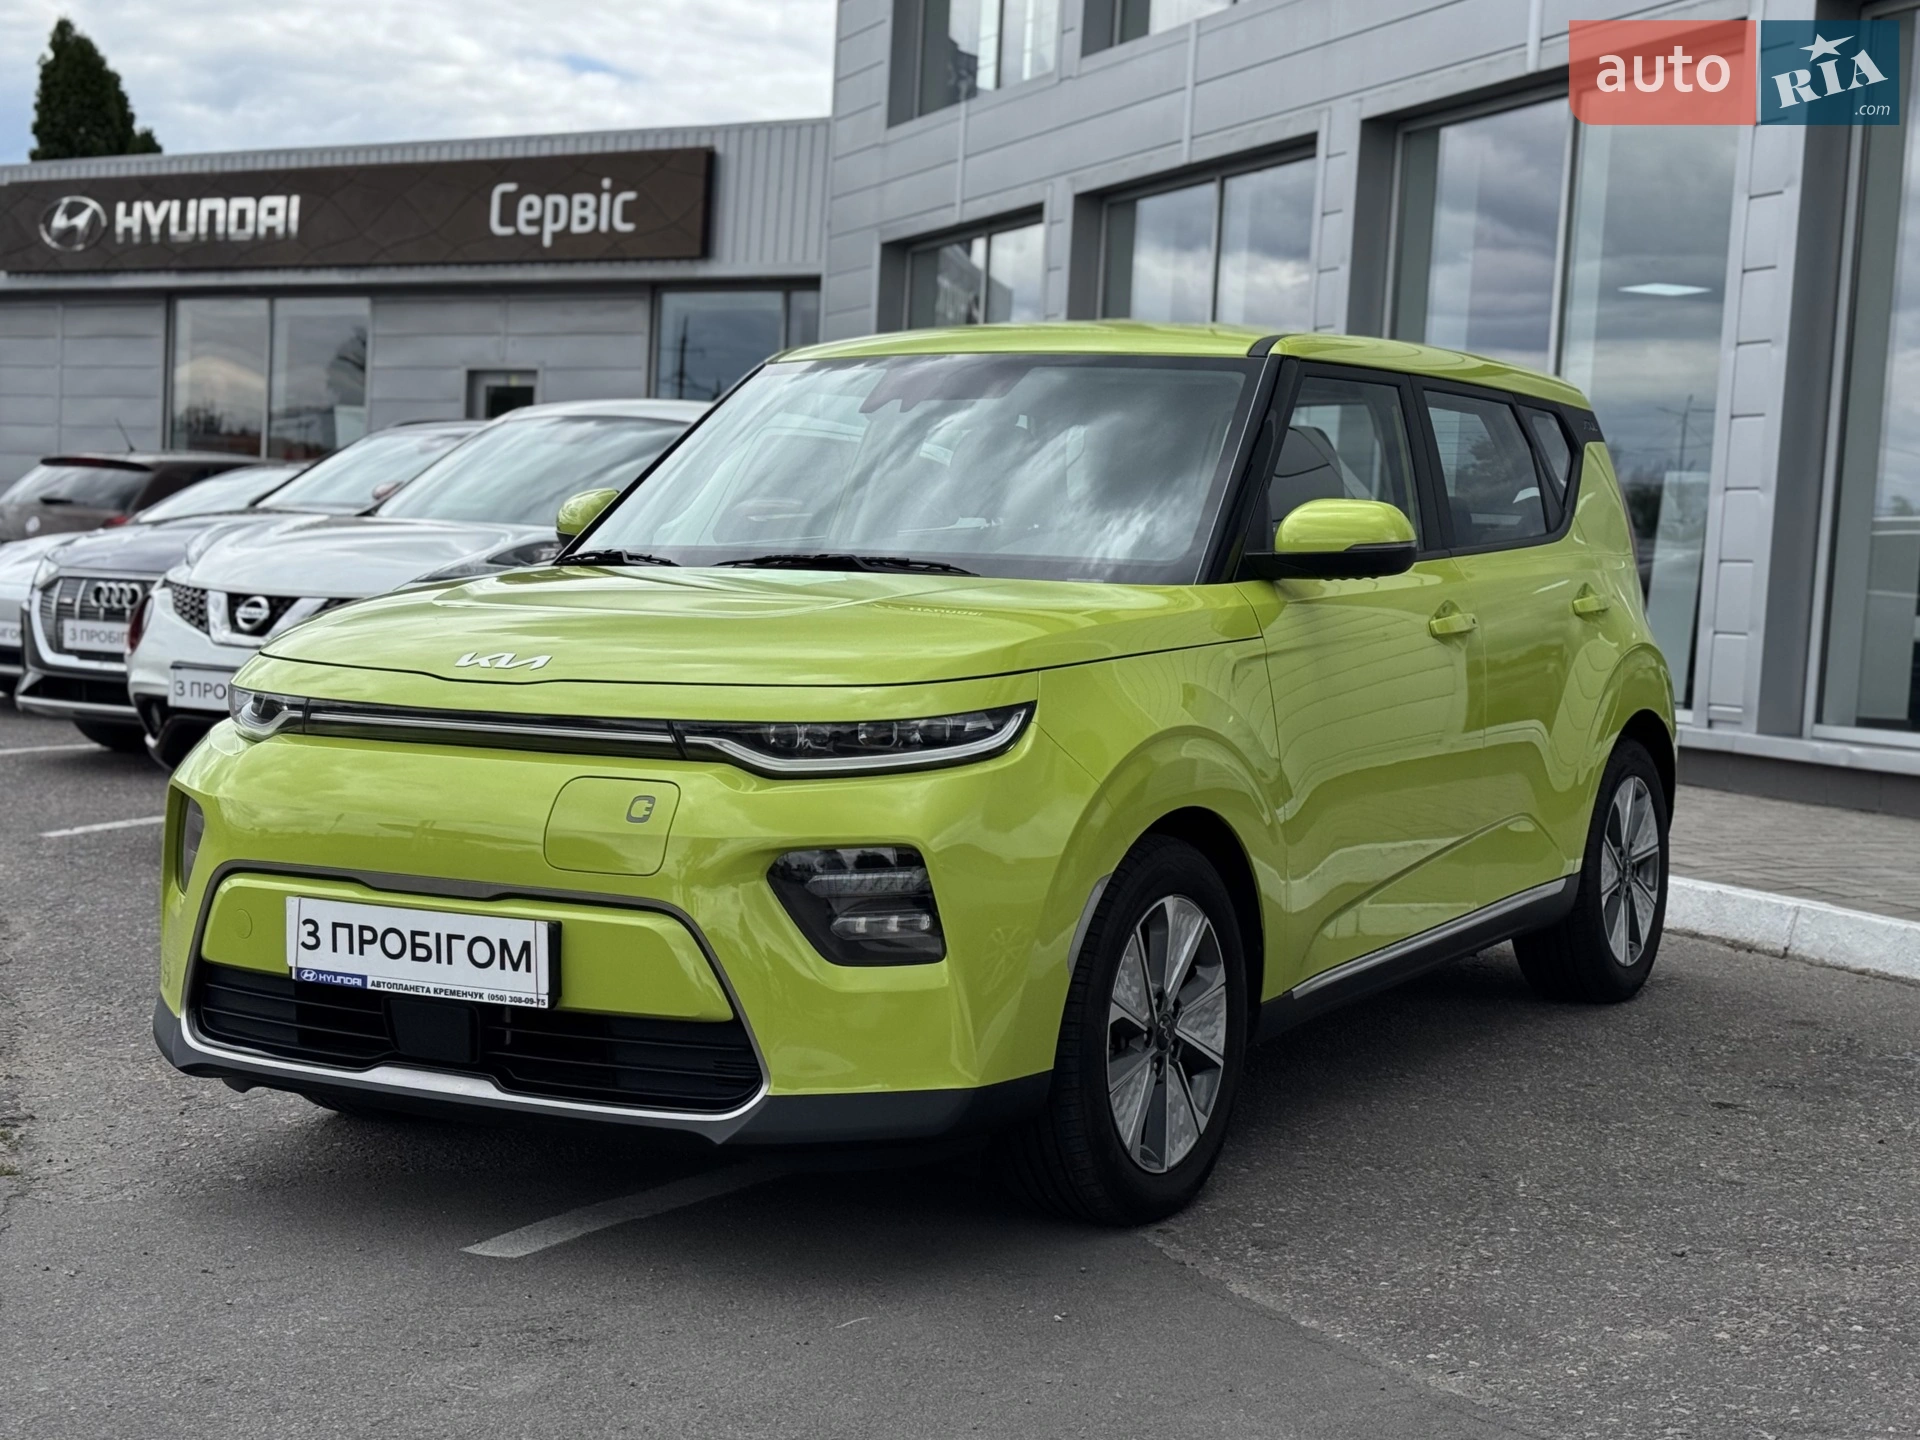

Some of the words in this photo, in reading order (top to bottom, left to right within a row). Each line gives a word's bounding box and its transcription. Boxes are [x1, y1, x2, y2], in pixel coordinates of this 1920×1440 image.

[114, 194, 301, 244] HYUNDAI
[489, 177, 638, 248] Сервіс
[455, 652, 553, 671] KIA
[175, 680, 186, 697] З
[300, 918, 321, 951] З
[331, 921, 532, 973] ПРОБІГОМ
[319, 973, 362, 987] HYUNDAI
[370, 980, 431, 994] АВТОПЛАНЕТА
[433, 987, 484, 1000] КРЕМЕНЧУК
[487, 992, 507, 1003] (050)
